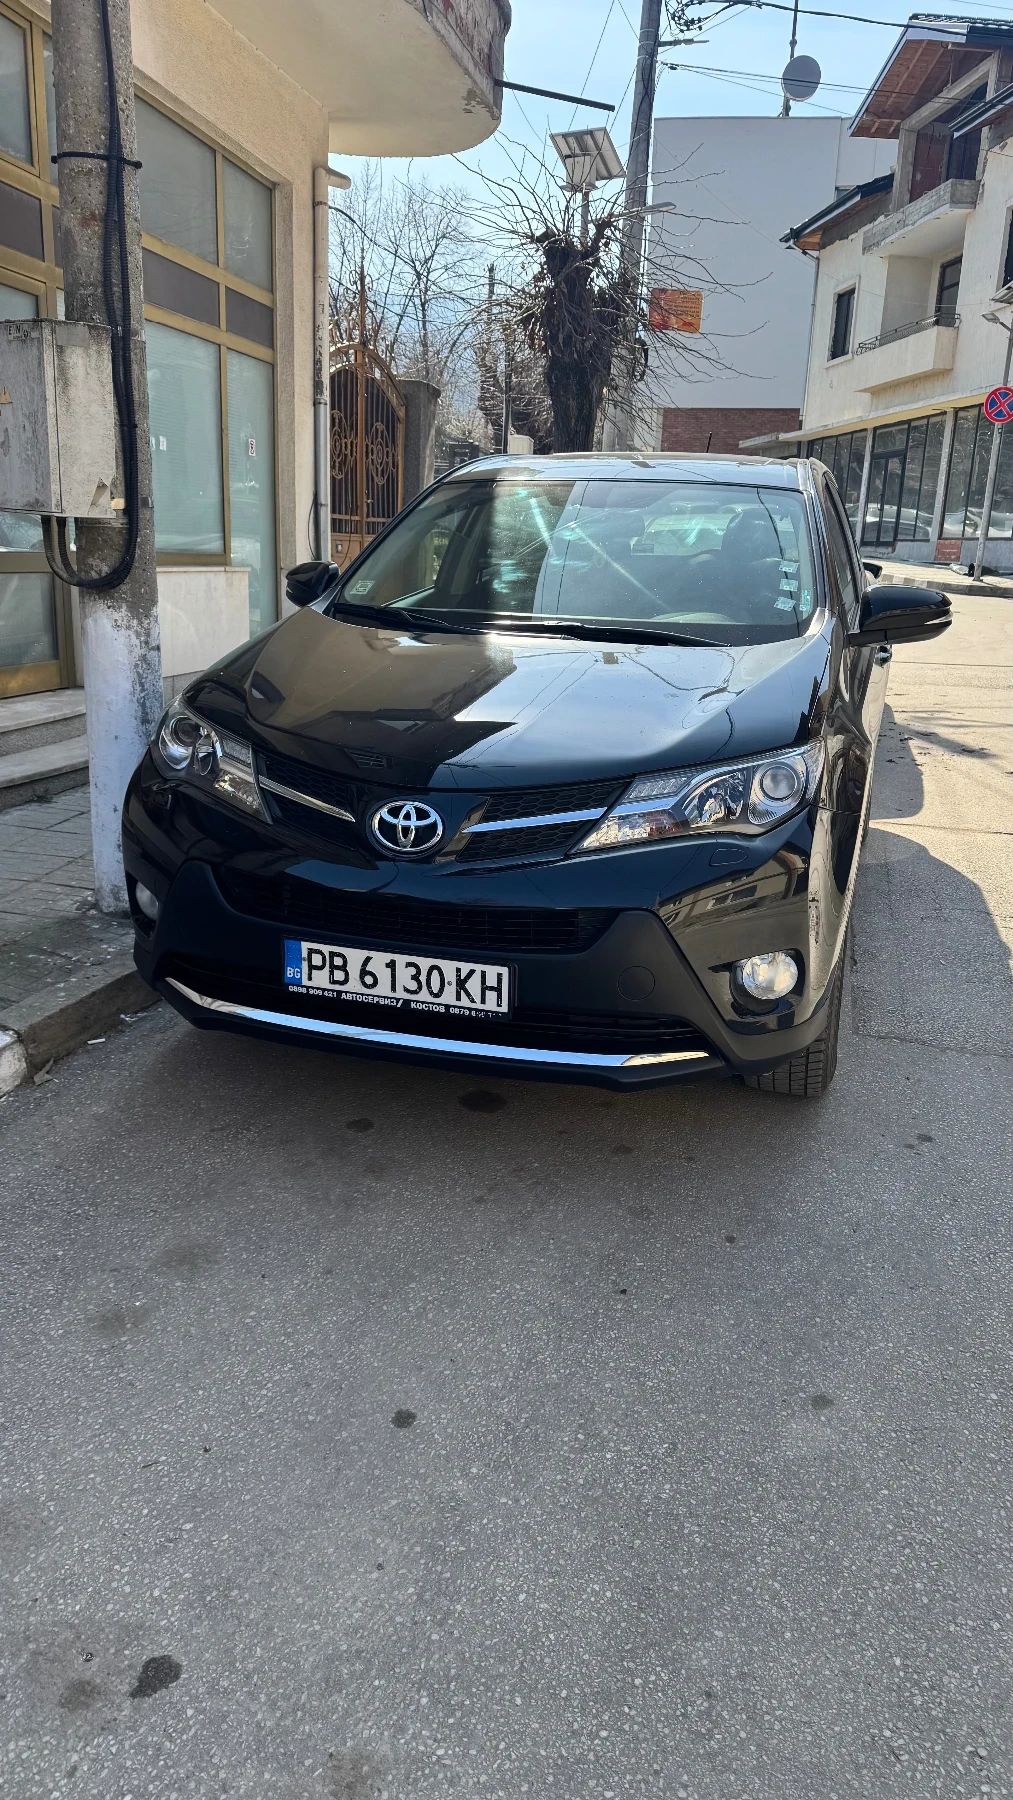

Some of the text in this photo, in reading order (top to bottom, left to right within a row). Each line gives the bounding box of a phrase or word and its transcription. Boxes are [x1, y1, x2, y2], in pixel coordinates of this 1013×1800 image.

[286, 966, 301, 978] BG
[307, 947, 503, 1008] PB 6130 KH
[288, 985, 307, 994] 0898
[308, 988, 323, 996] 909
[323, 990, 337, 998] 421
[410, 1001, 446, 1013] КОСТОВ
[449, 1007, 470, 1016] 0879
